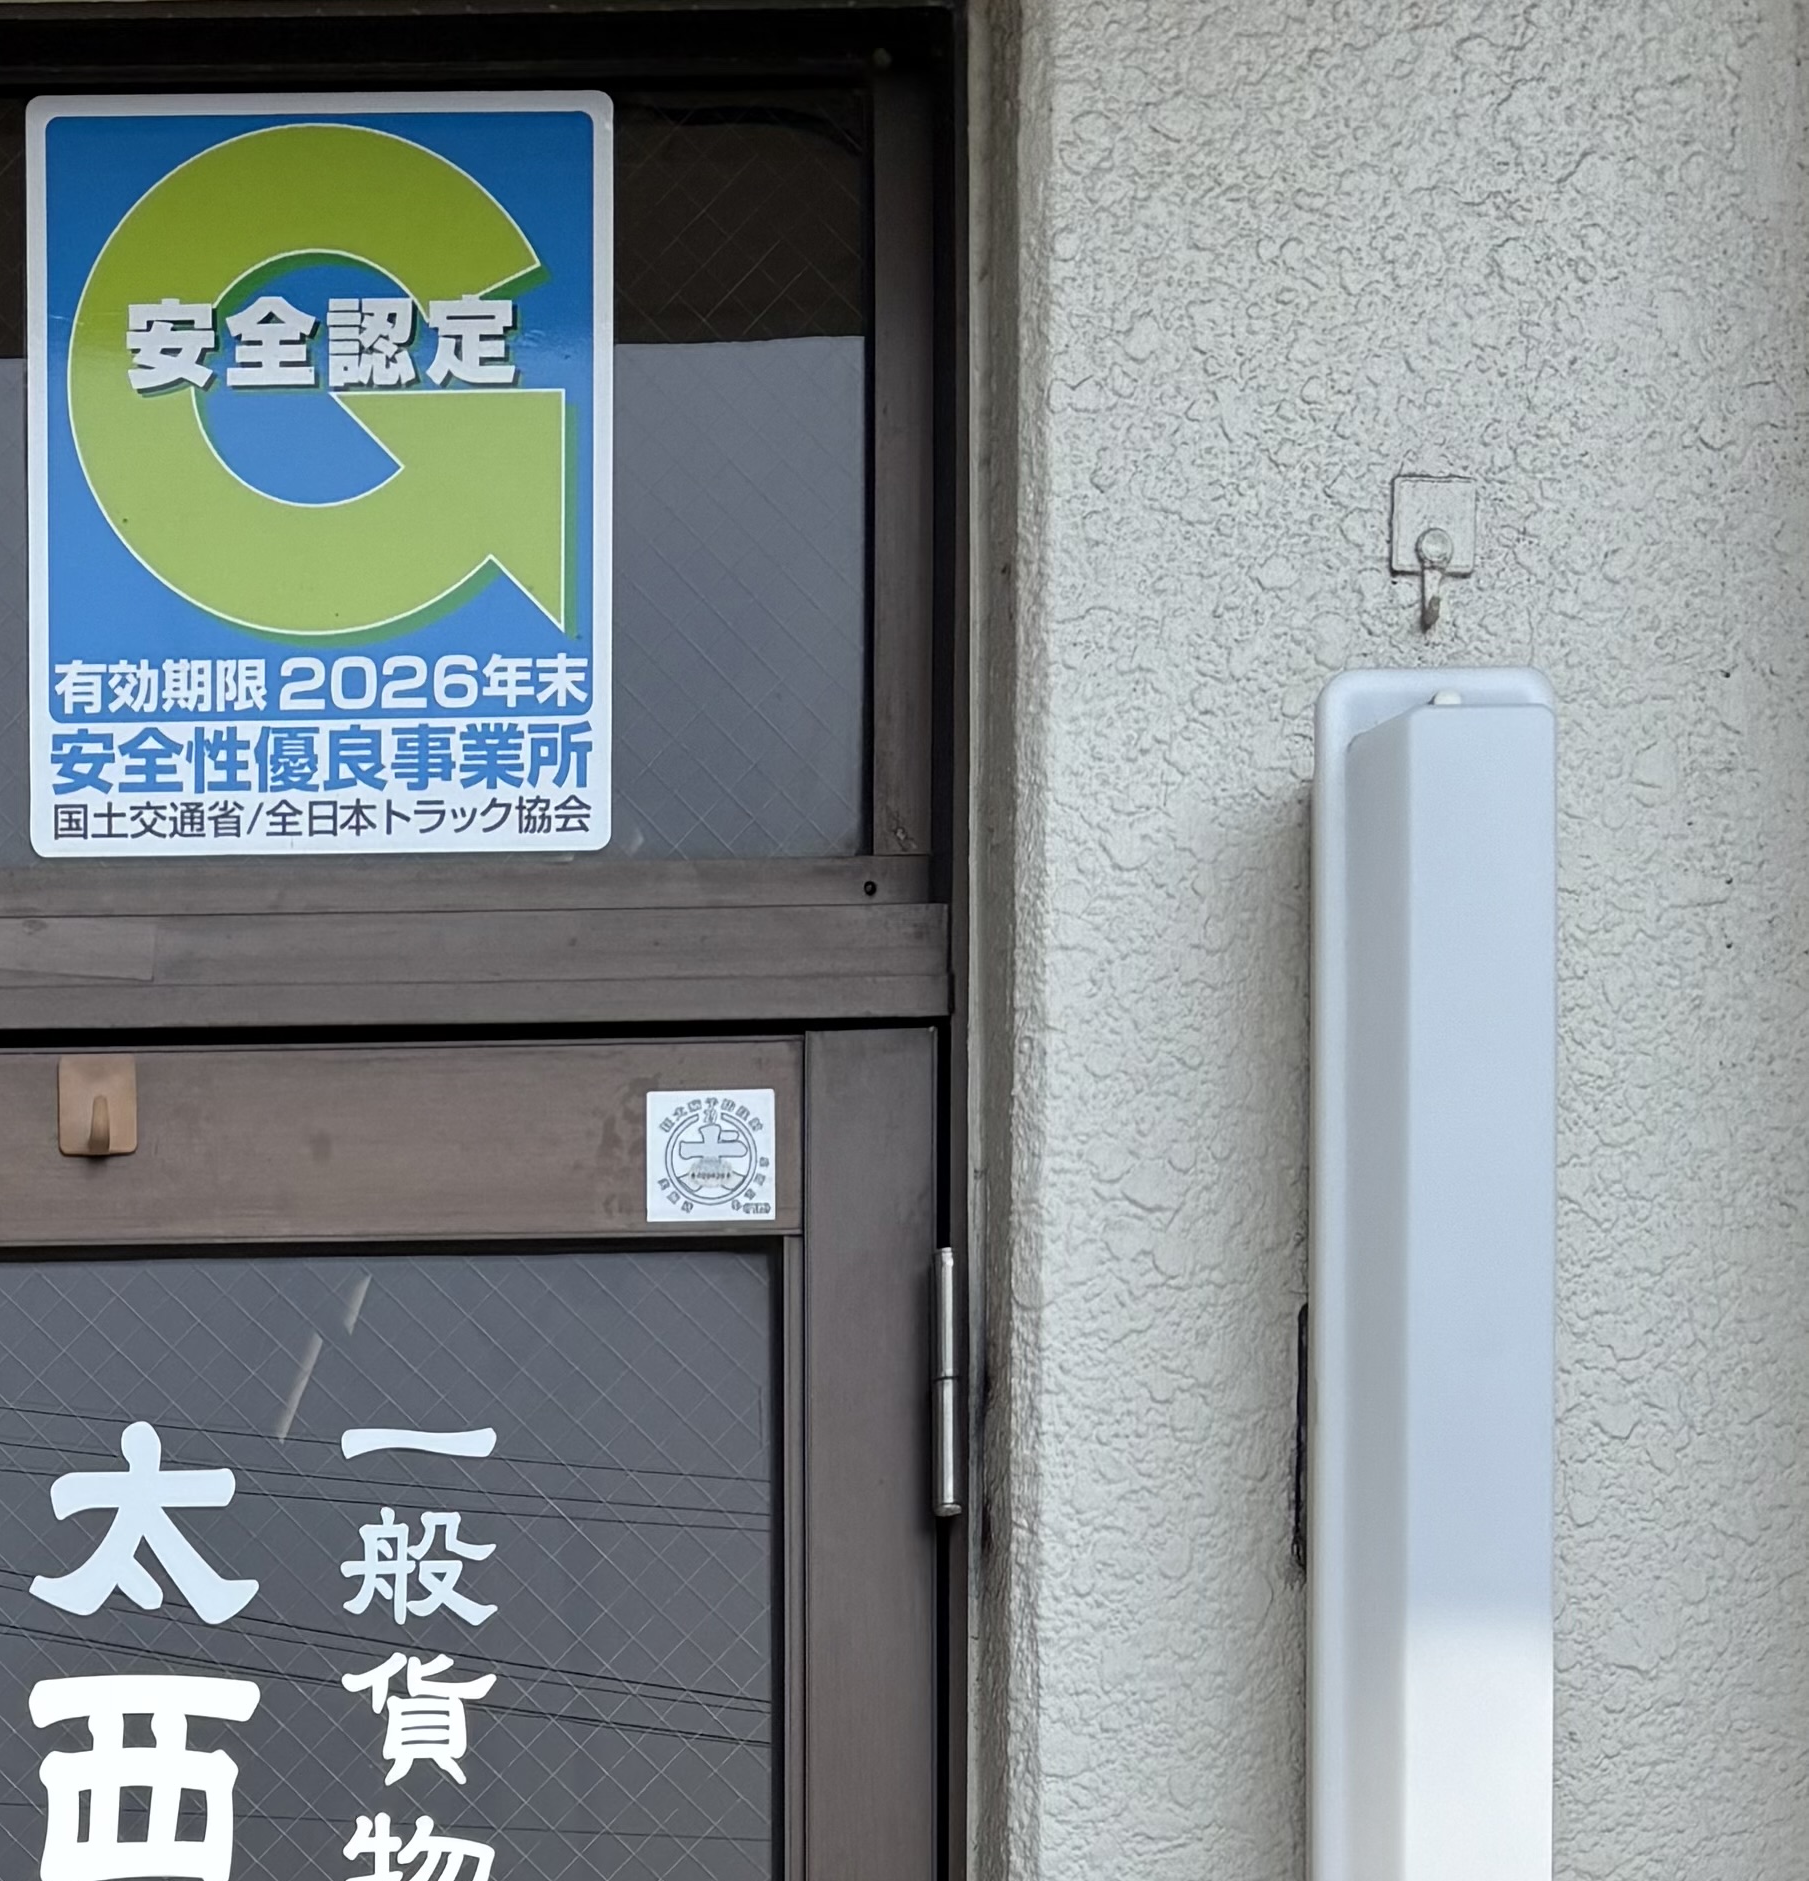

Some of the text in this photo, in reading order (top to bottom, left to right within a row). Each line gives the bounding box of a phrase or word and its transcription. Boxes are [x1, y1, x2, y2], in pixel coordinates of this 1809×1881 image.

[125, 296, 521, 390] 安全認定
[50, 722, 593, 794] 安全性優良事業所
